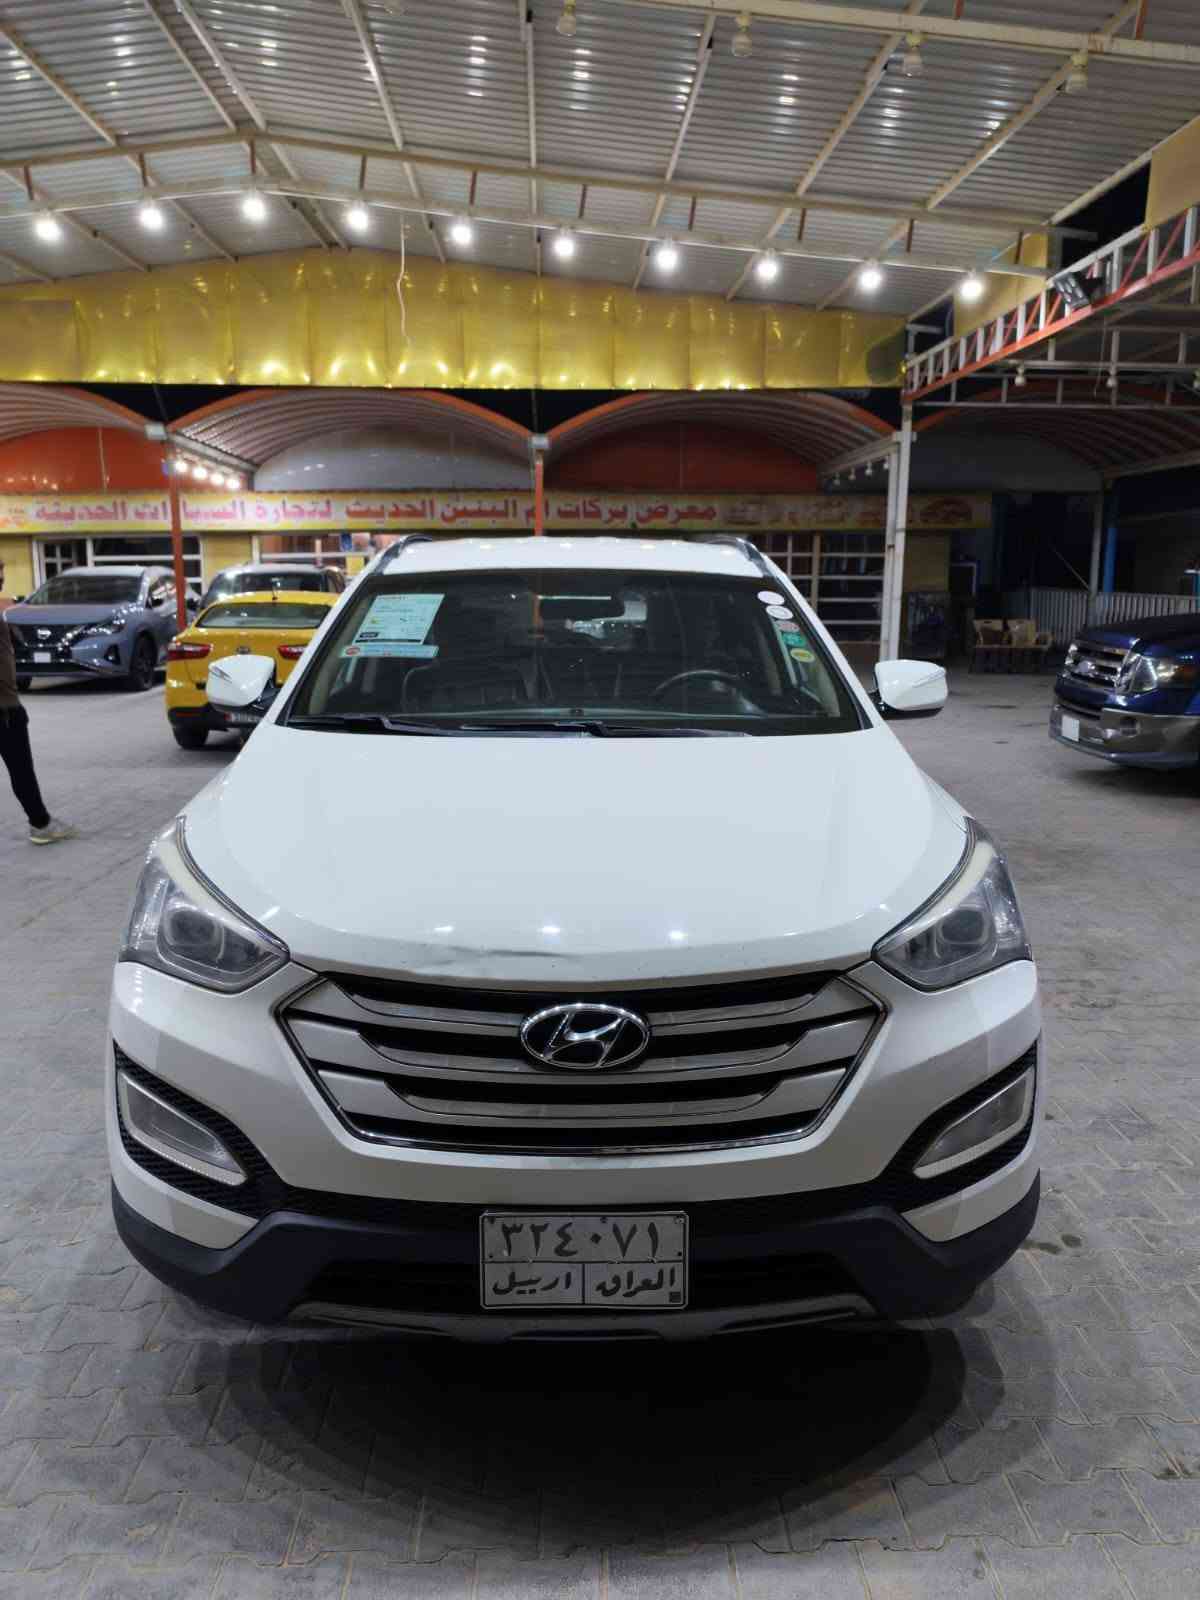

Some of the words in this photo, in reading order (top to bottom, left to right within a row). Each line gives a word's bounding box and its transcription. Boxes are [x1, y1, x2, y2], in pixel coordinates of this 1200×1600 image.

[134, 500, 245, 527] السياات
[256, 499, 332, 523] لتجارة
[345, 497, 434, 524] الحديث
[440, 496, 517, 525] البنين
[557, 499, 628, 525] بركات
[635, 500, 716, 525] معرض
[502, 1221, 660, 1259] ٣٢٤٠٧١
[492, 1271, 573, 1296] اربيل
[595, 1265, 677, 1298] العراق
